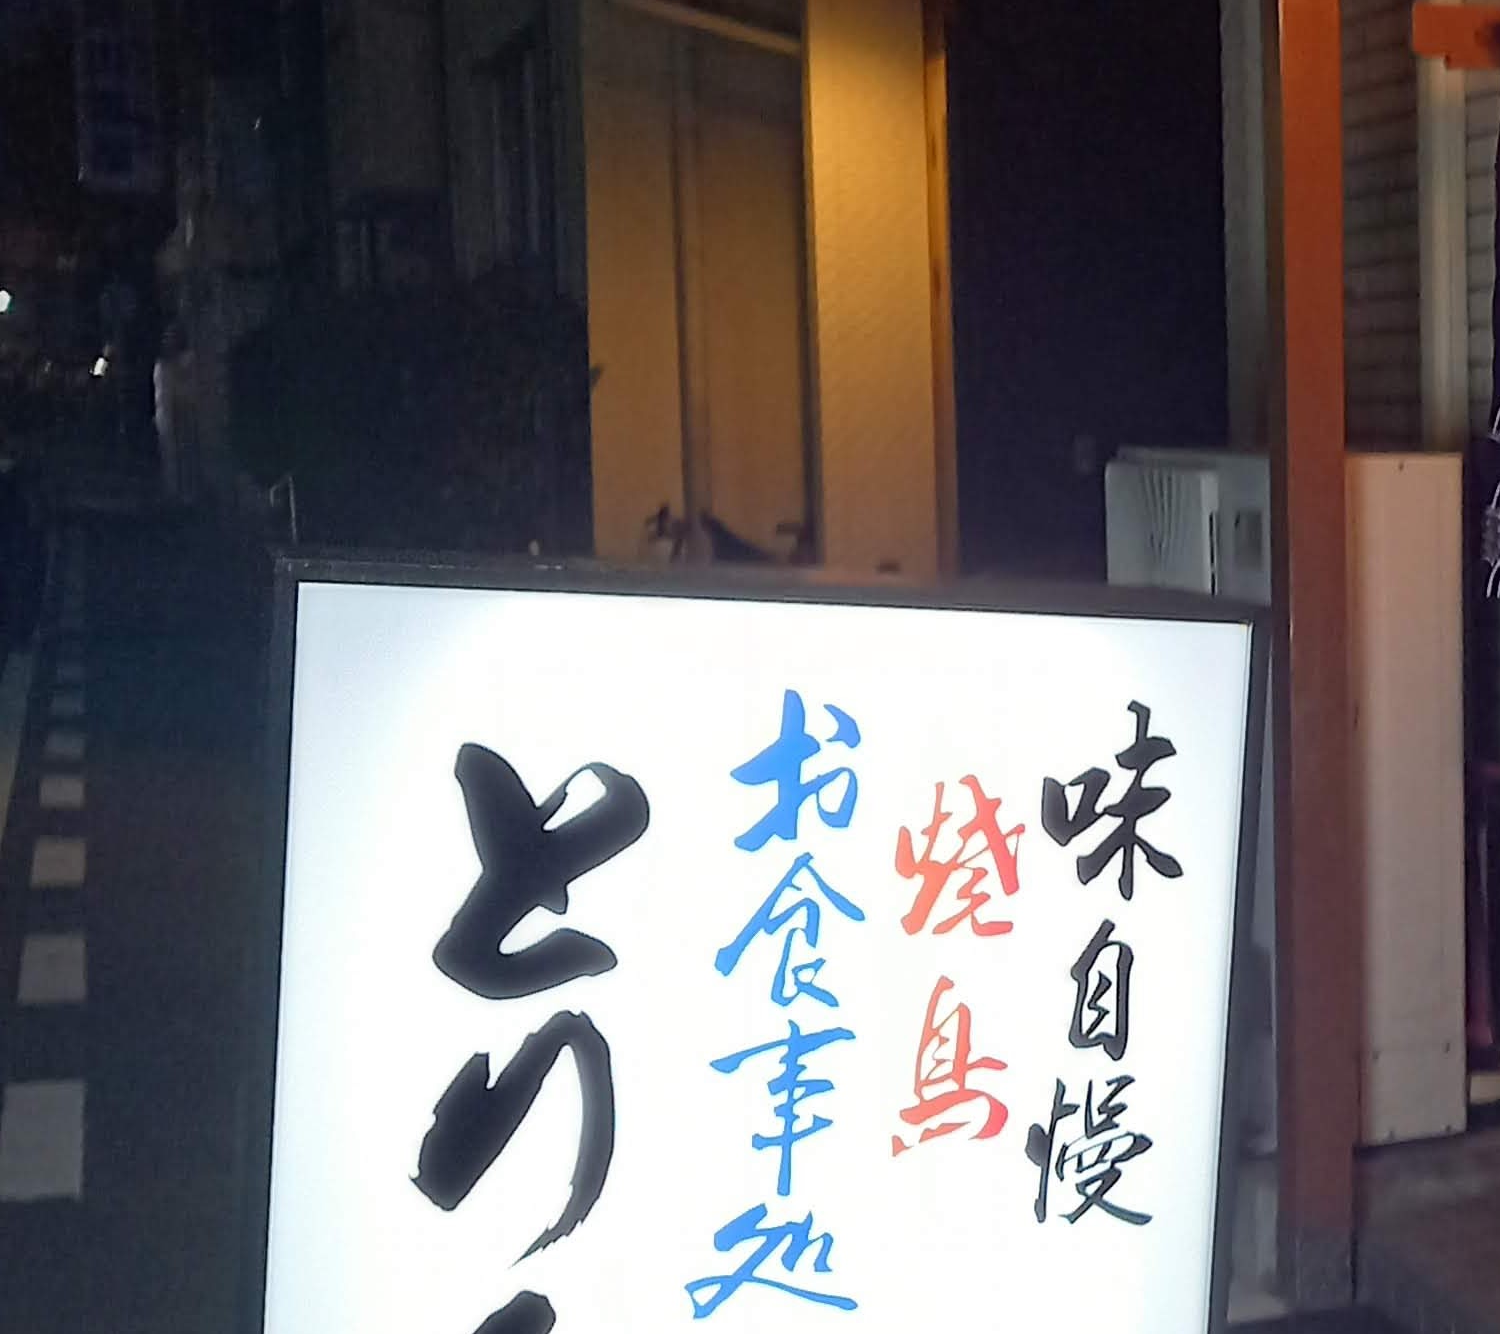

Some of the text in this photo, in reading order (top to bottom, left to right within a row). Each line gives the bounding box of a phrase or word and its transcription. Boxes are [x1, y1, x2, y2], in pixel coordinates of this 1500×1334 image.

[684, 689, 866, 1320] お食事処
[1026, 701, 1184, 1226] 味自慢
